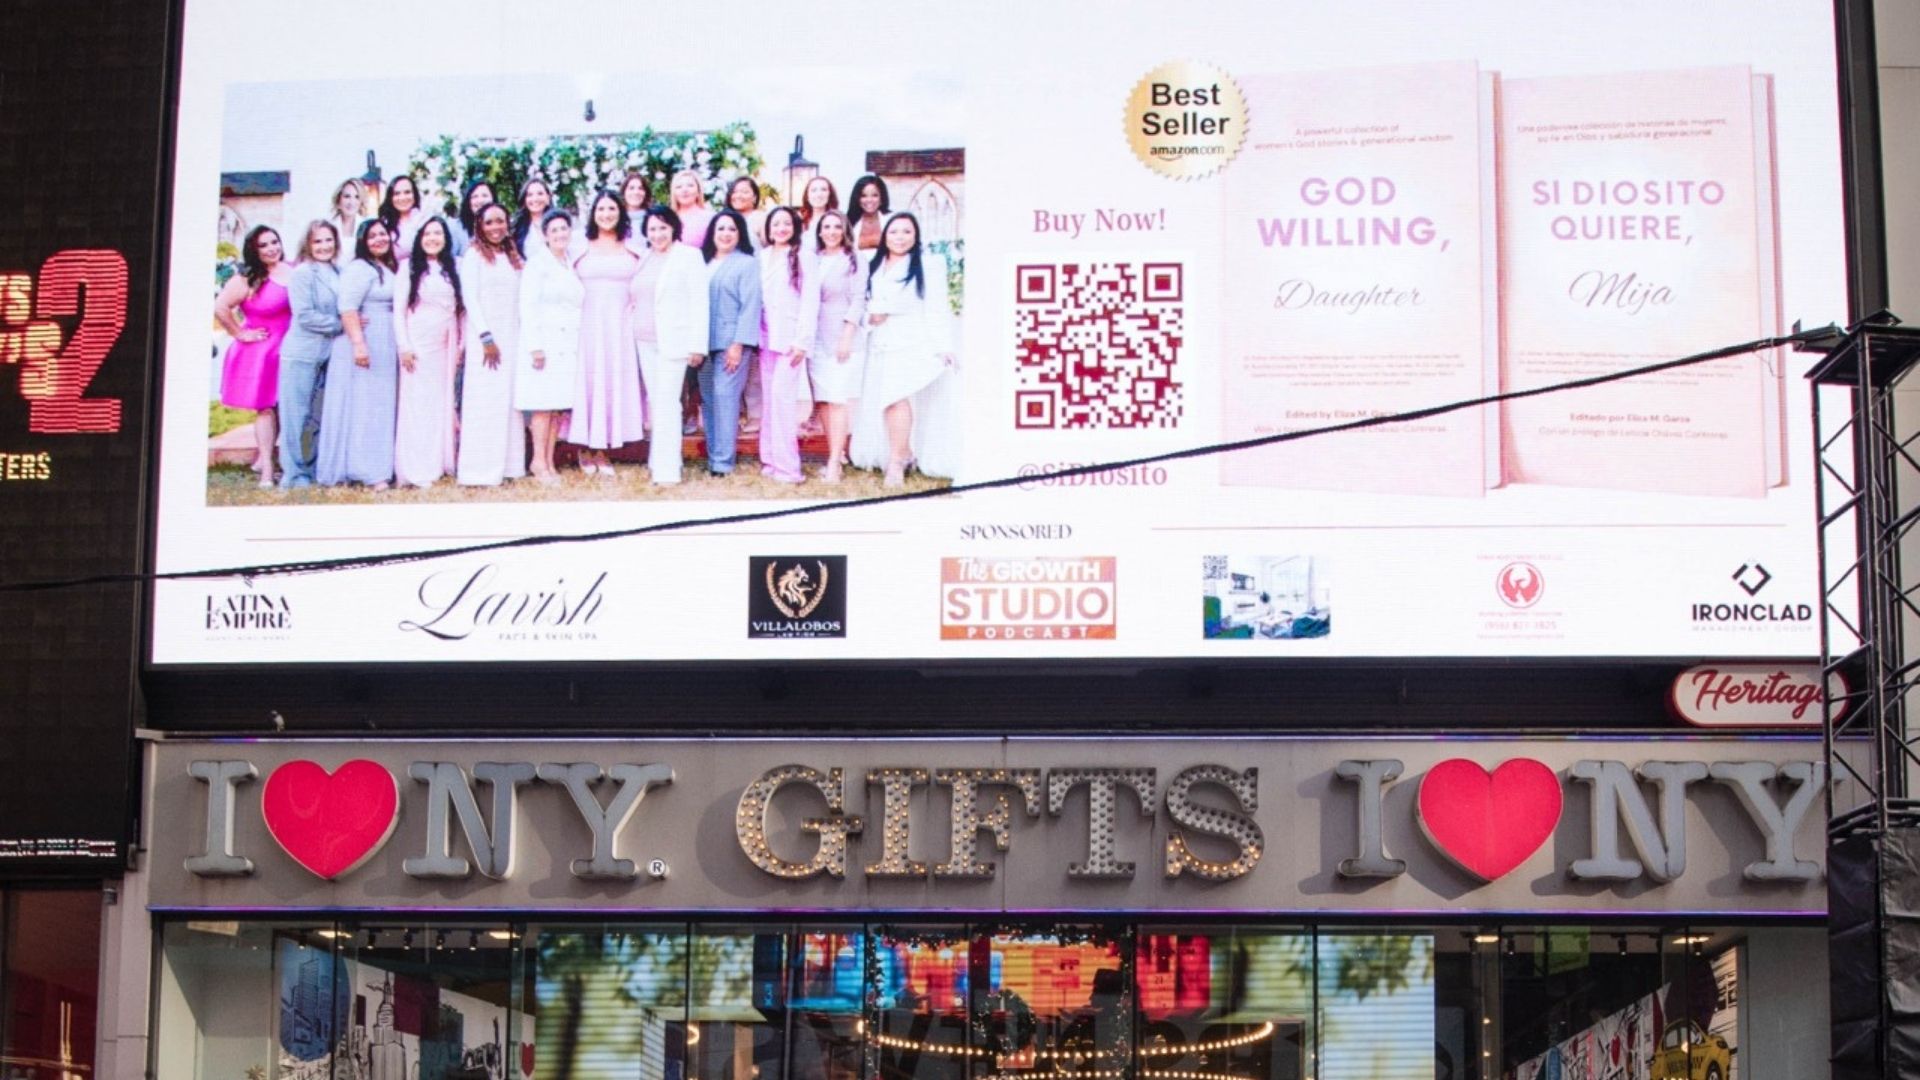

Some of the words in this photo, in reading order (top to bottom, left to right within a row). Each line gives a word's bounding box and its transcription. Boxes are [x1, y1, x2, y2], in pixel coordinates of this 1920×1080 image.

[1151, 83, 1221, 106] Best
[1142, 112, 1230, 136] Seller
[1300, 177, 1396, 206] GOD
[1532, 180, 1561, 205] SI
[1573, 180, 1725, 205] DIOSITO
[1033, 209, 1086, 239] Buy
[1095, 208, 1166, 231] Now!
[1257, 216, 1450, 252] WILLING,
[1551, 214, 1693, 246] QUIERE,
[1273, 279, 1424, 315] Daughter
[1568, 270, 1675, 315] Mija
[29, 249, 128, 433] 2
[960, 524, 1072, 540] SPONSORED
[994, 561, 1100, 581] GROWTH
[207, 594, 291, 614] LATINA
[398, 563, 610, 640] Lavish
[948, 587, 1109, 620] STUDIO
[1692, 604, 1812, 621] IRONCLAD
[206, 612, 292, 629] EMPIRE
[752, 621, 841, 632] VILLALOBOS
[968, 627, 1088, 639] PODCAST
[186, 759, 259, 876] I
[402, 760, 676, 879] NY
[736, 764, 1265, 880] GIFTS
[1336, 759, 1405, 879] I
[1567, 760, 1846, 882] NY
